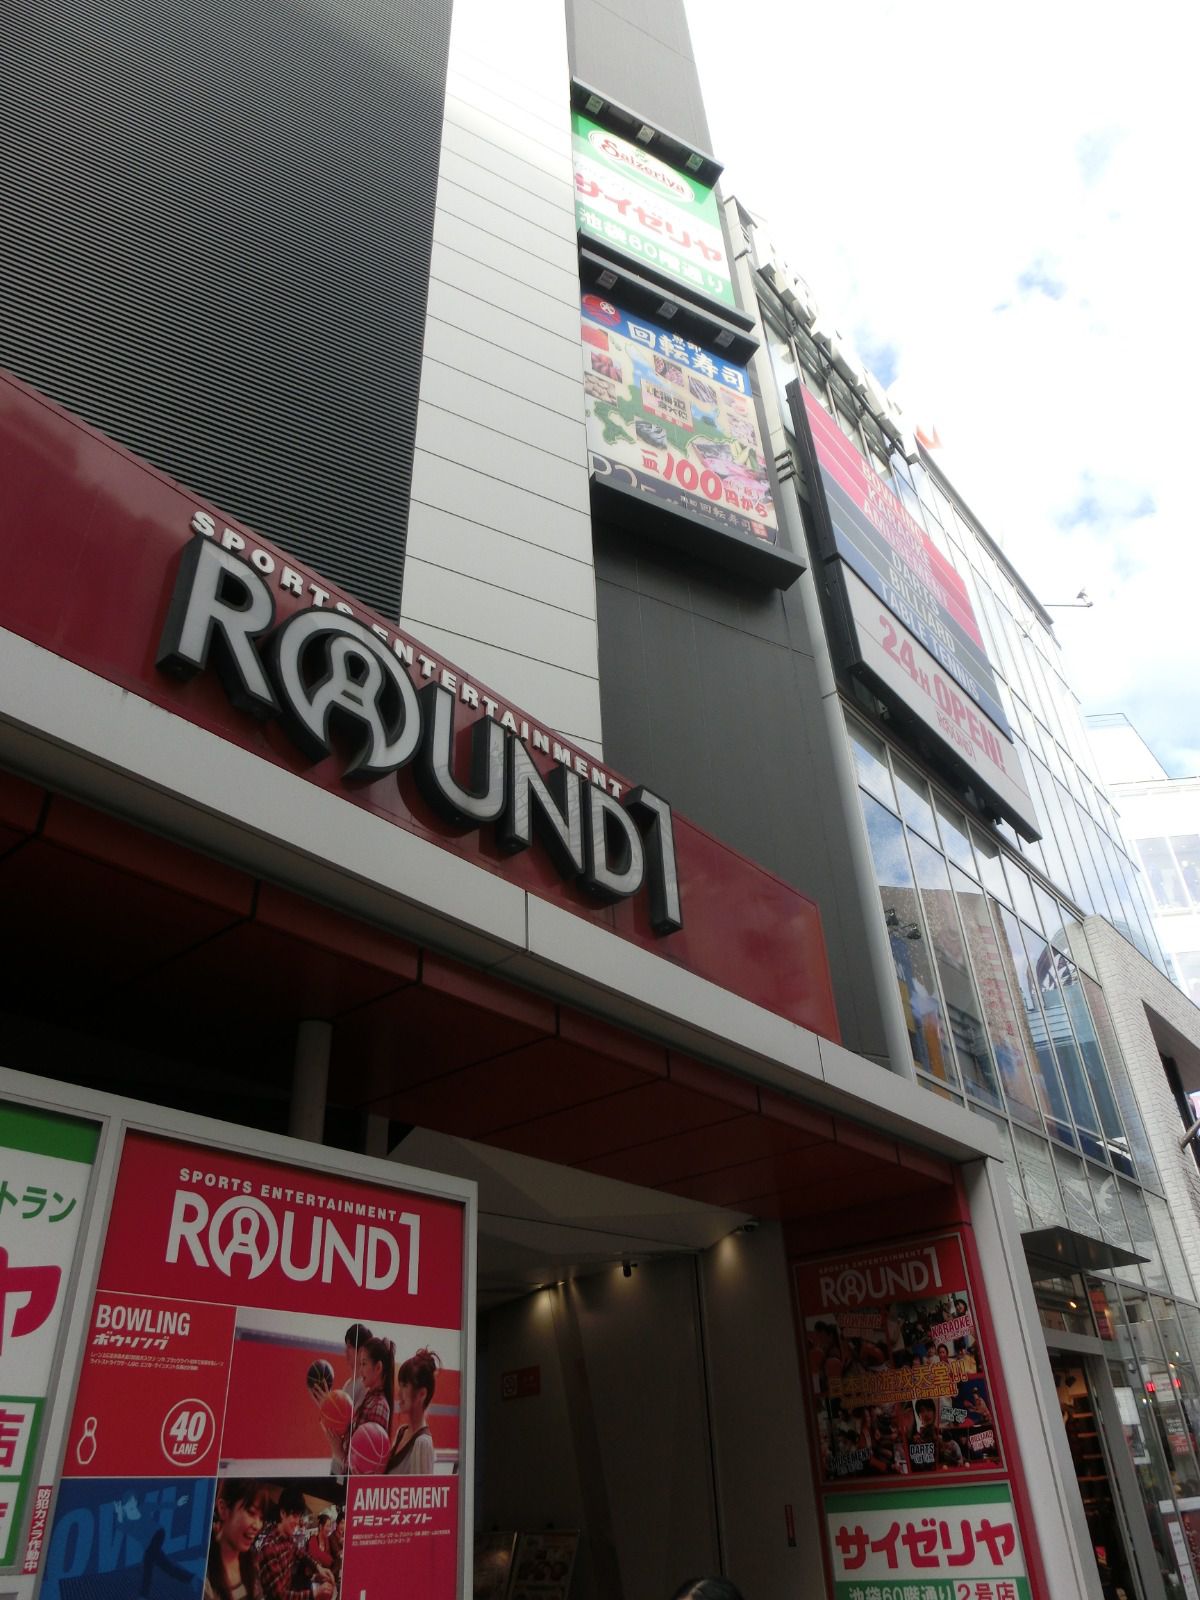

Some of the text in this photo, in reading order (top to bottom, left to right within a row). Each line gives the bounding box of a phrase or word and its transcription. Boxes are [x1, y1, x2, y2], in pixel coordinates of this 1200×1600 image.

[600, 139, 685, 193] Saizeriya
[576, 173, 722, 261] サイゼリヤ
[627, 321, 745, 383] 回転寿司
[861, 459, 925, 546] BOWLING
[866, 483, 931, 567] KARAOKE
[863, 499, 951, 610] AMUSEMENT
[890, 549, 941, 617] DARTS
[878, 576, 980, 702] TABLE TENNIS
[888, 566, 957, 655] BILLIARD
[160, 533, 682, 935] ROUND1
[932, 673, 1008, 776] OPEN!
[179, 1167, 397, 1223] SPORTS ENTERTAINMENT
[165, 1189, 420, 1295] ROUND1
[820, 1246, 943, 1308] ROUND1
[92, 1331, 170, 1350] ボウリング
[95, 1304, 191, 1337] BOWLING
[931, 1314, 971, 1338] KARAOKE
[169, 1411, 206, 1442] 40
[172, 1443, 198, 1455] LANE
[911, 1444, 934, 1456] DARTS
[352, 1511, 432, 1527] アミューズメント
[353, 1486, 450, 1511] AMUSEMENT
[23, 1486, 51, 1574] 防犯カメラ作動中
[835, 1518, 1015, 1569] サイゼリヤ
